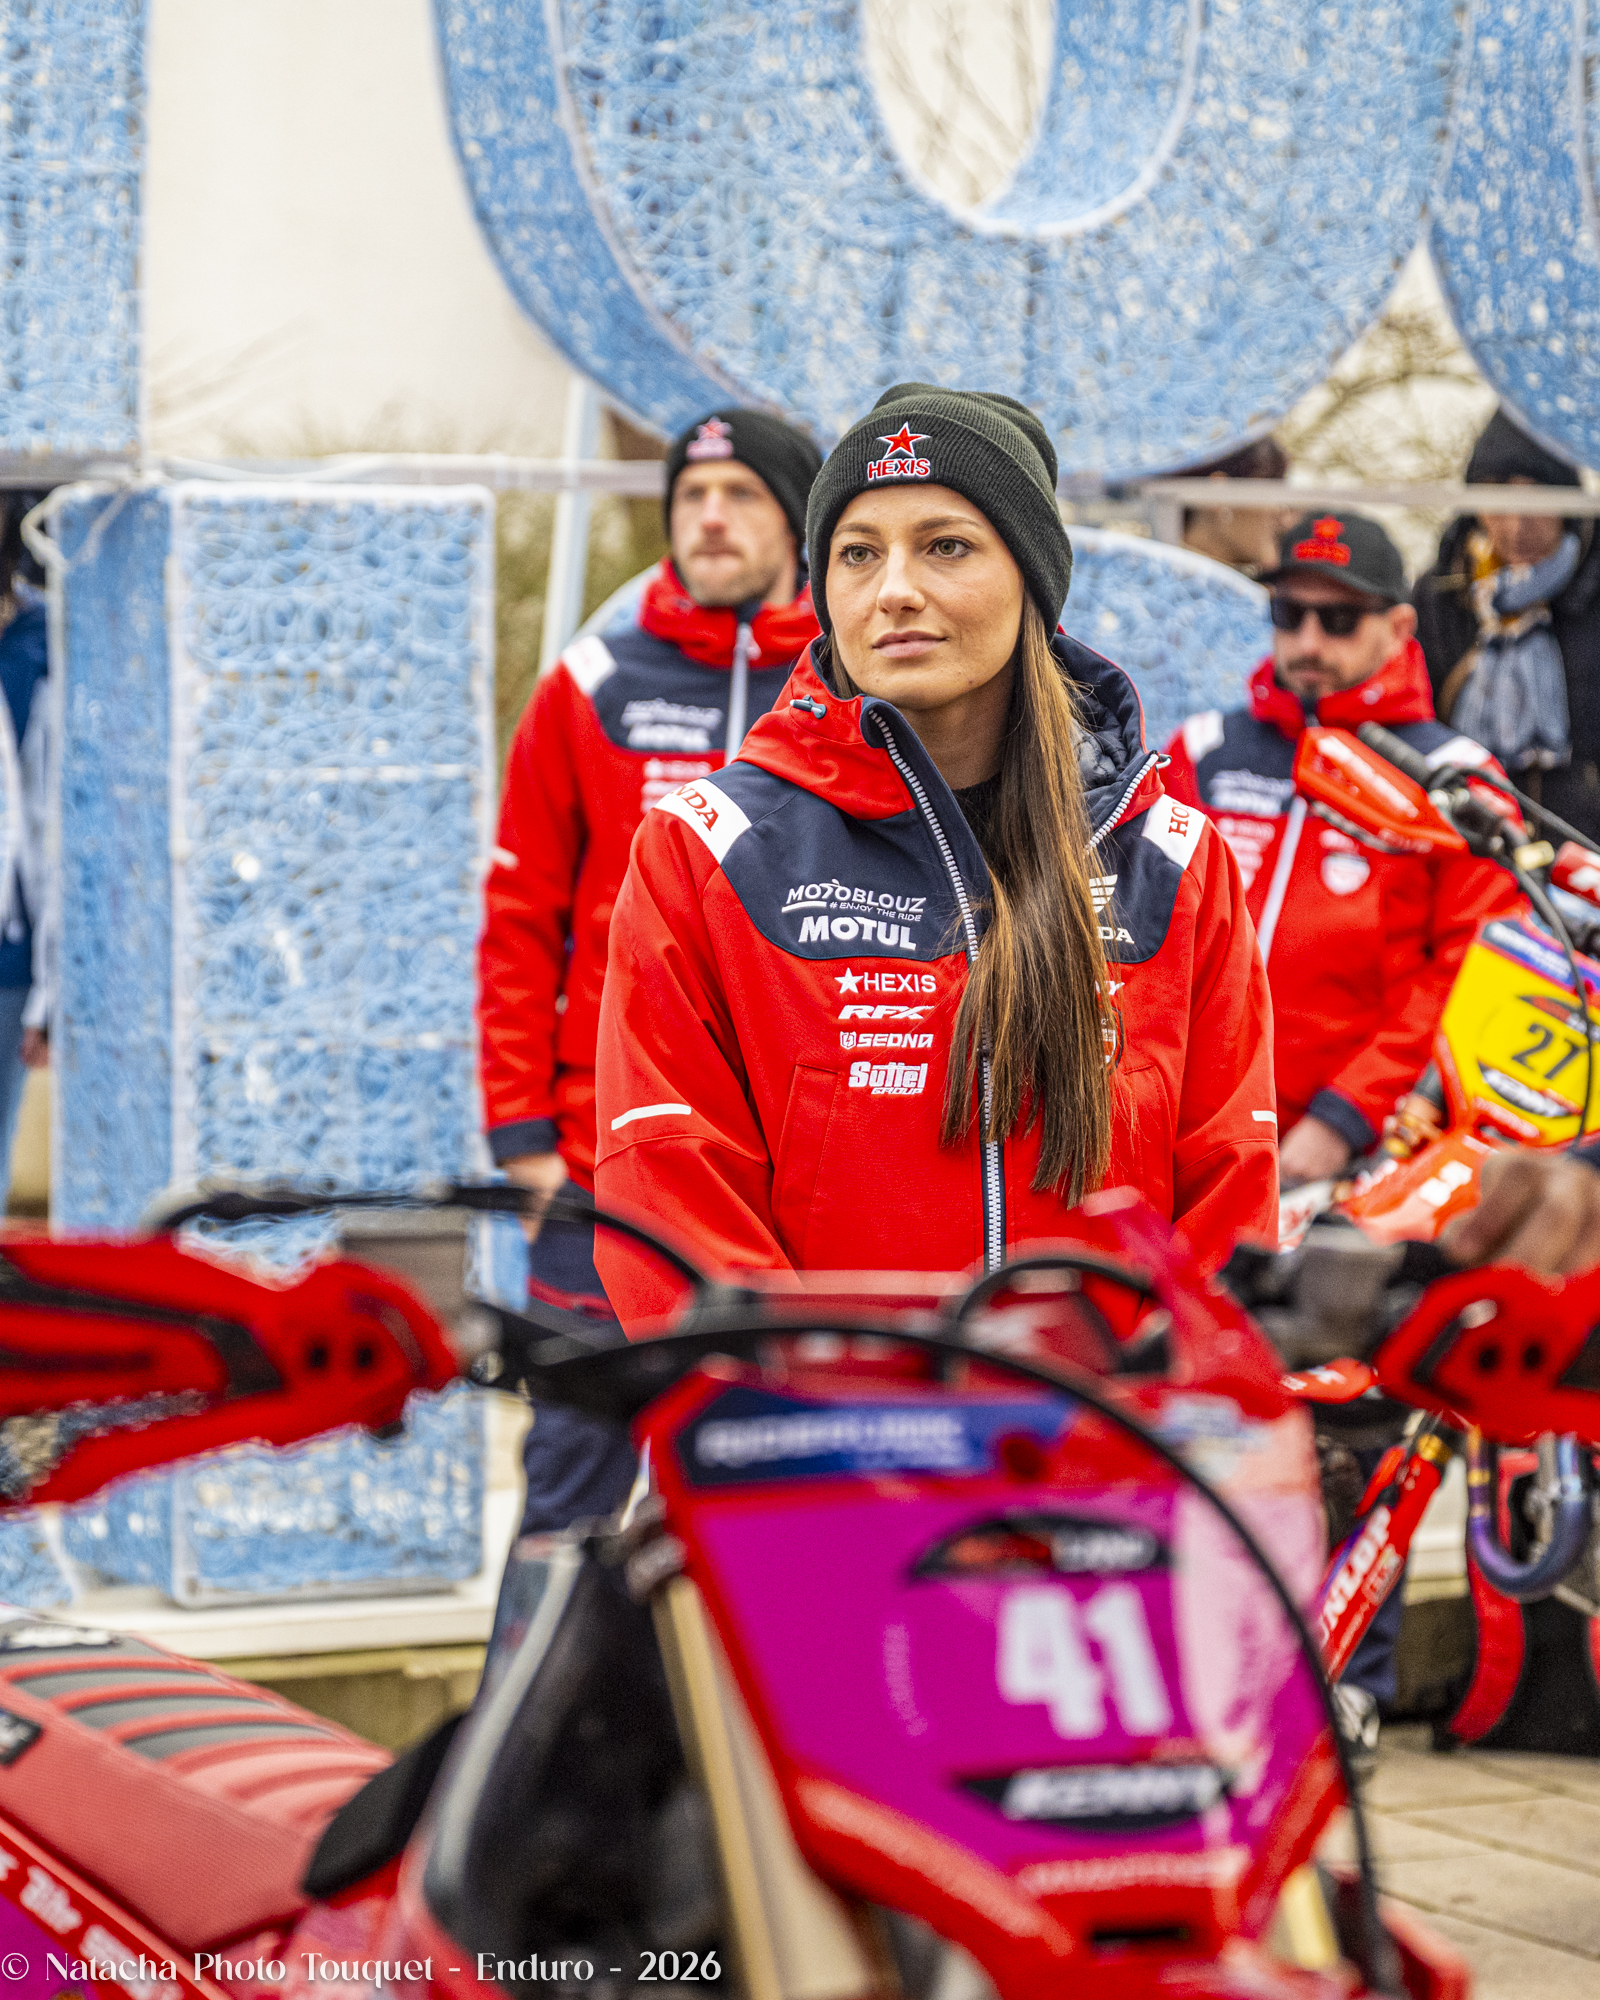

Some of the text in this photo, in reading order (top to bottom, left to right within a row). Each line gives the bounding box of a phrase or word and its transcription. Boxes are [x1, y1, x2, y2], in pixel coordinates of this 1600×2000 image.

[867, 458, 931, 481] HEXIS
[670, 785, 719, 832] NDA
[785, 882, 927, 913] MOTOBLOUZ
[839, 902, 874, 913] ENJOY
[876, 907, 896, 919] THE
[897, 912, 923, 923] RIDE
[798, 915, 917, 951] MOTUL
[1097, 925, 1135, 945] DA
[863, 971, 937, 993] HEXIS
[838, 1004, 935, 1020] RFX
[856, 1033, 934, 1049] SEDNA
[1510, 1022, 1588, 1080] 27
[871, 1086, 924, 1096] GROUP
[996, 1582, 1173, 1740] 41
